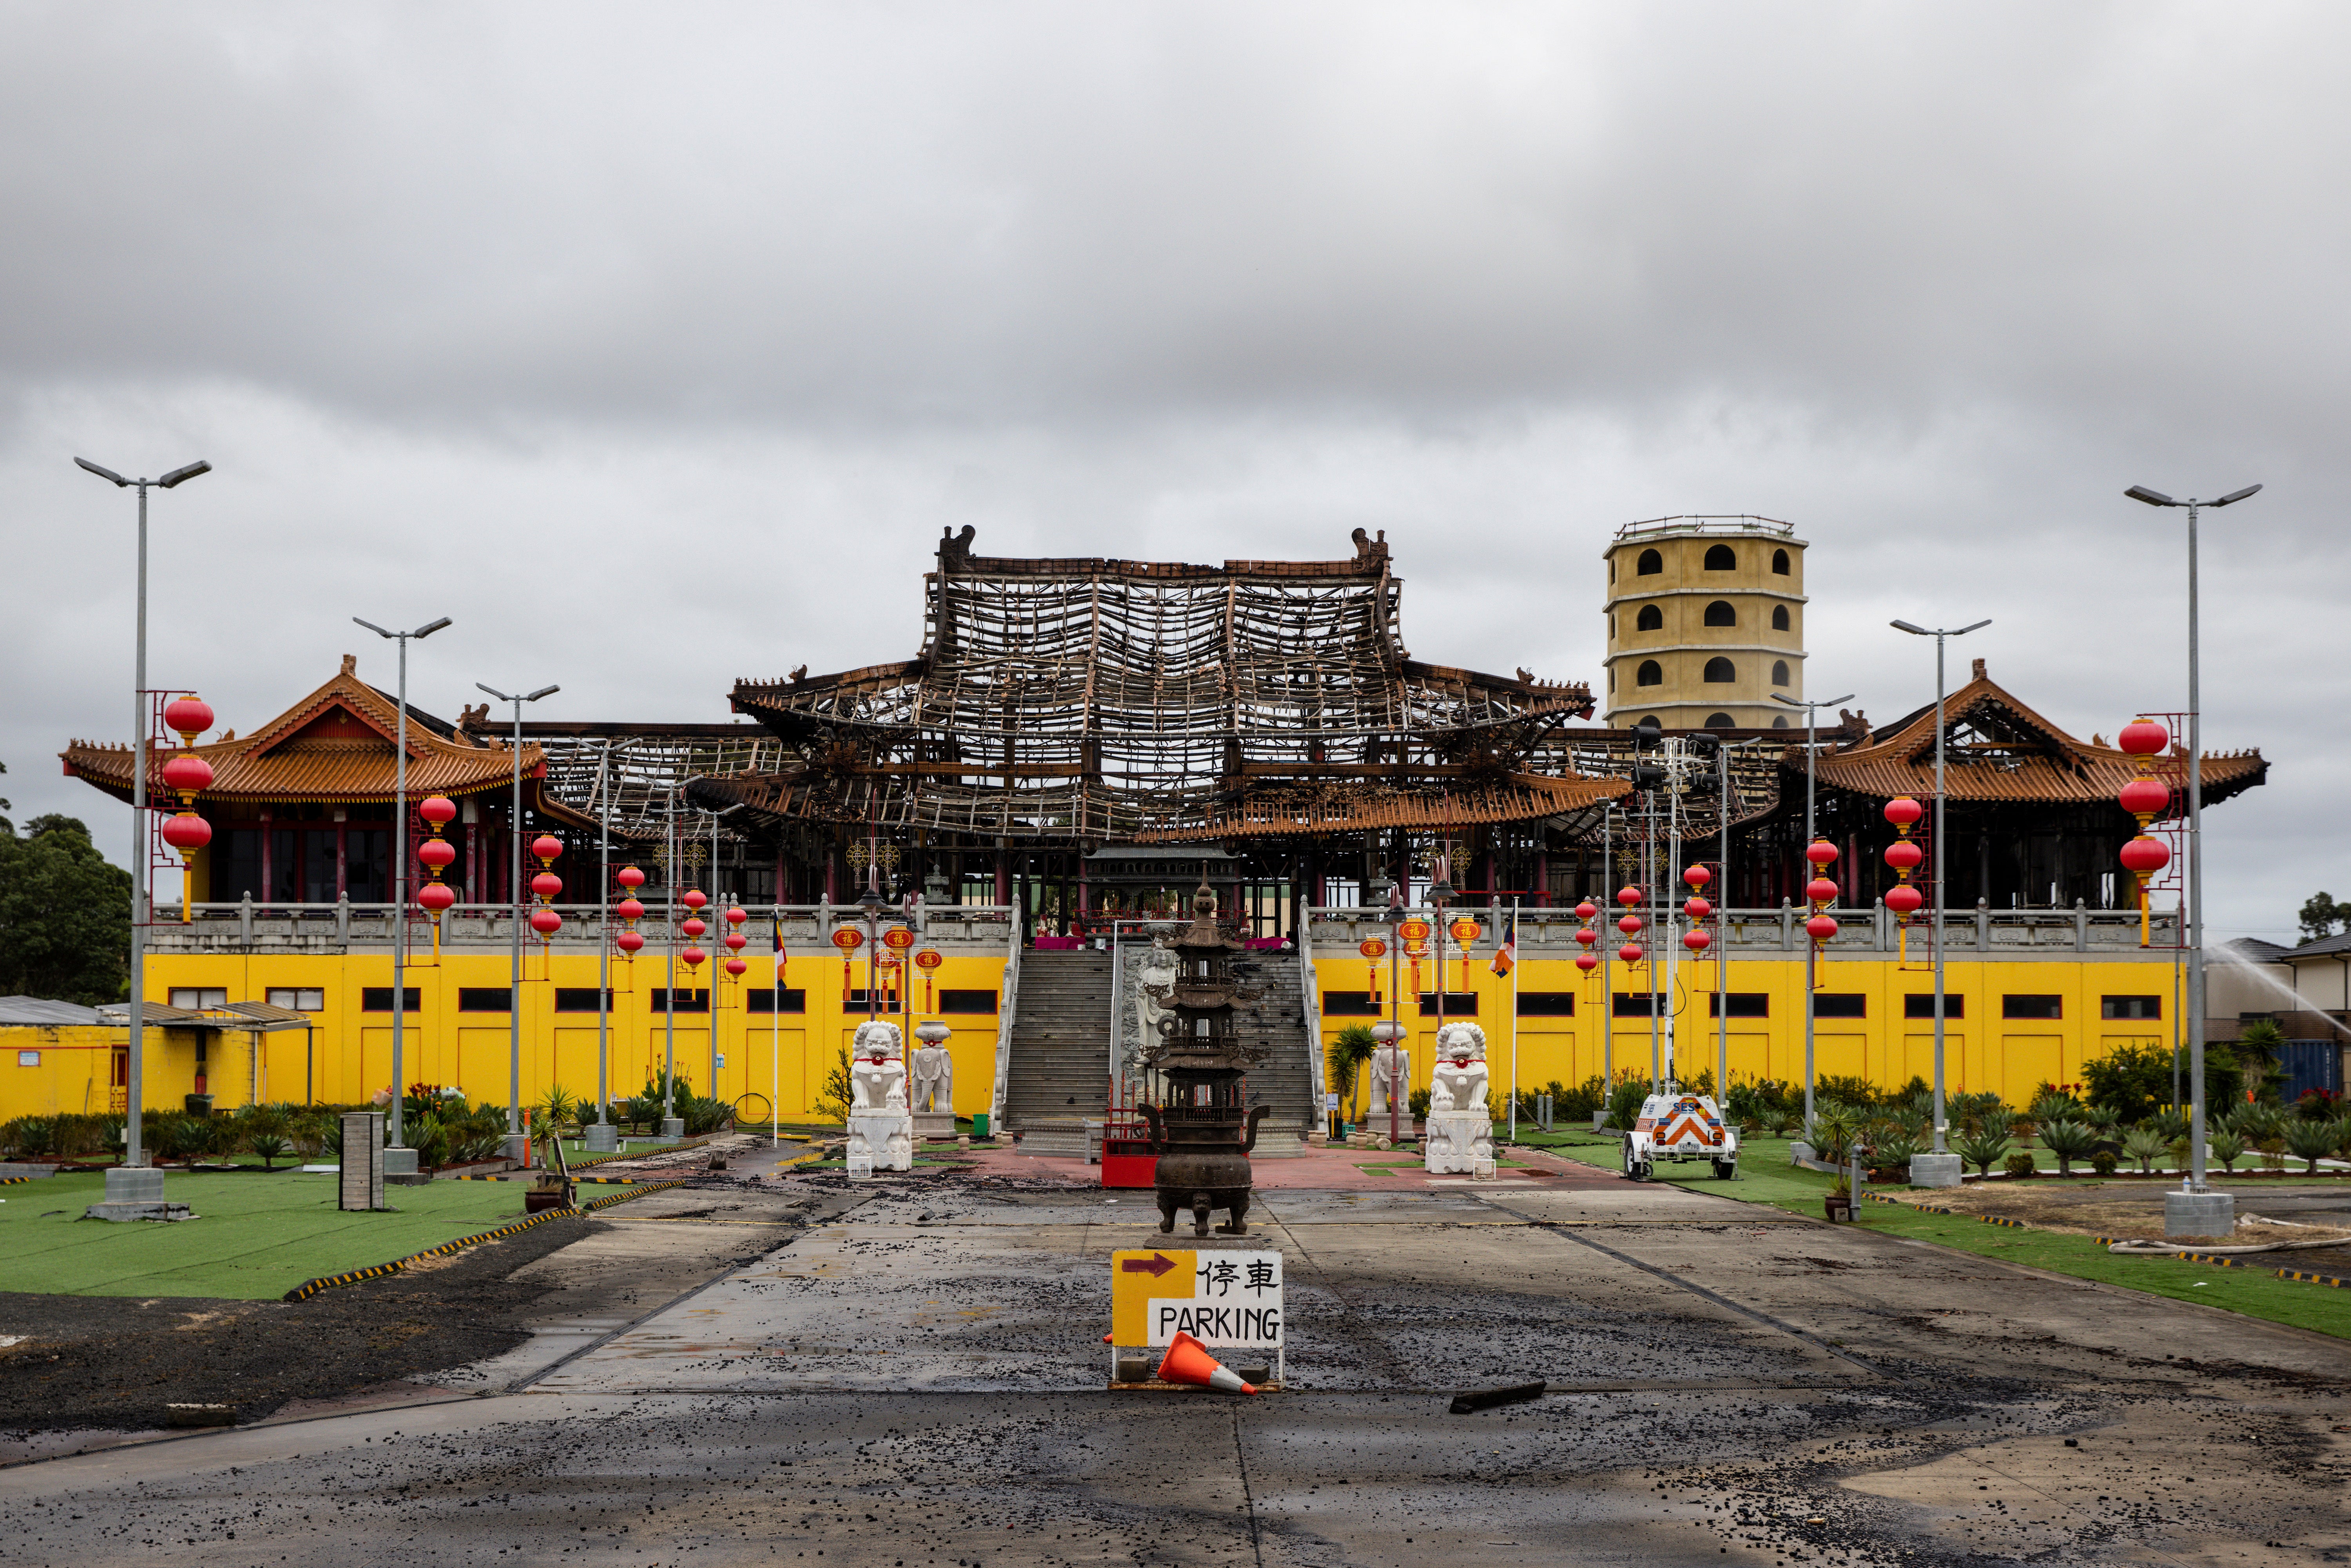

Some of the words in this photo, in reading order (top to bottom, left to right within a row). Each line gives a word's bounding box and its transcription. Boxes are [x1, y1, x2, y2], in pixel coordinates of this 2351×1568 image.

[1409, 925, 1420, 936] 福
[1460, 925, 1471, 936] 福
[842, 934, 853, 944] 福
[893, 934, 904, 944] 福
[1369, 944, 1378, 953] 福
[924, 955, 933, 964] 福
[1673, 1103, 1695, 1112] SES
[1197, 1258, 1280, 1298] 停車
[1161, 1307, 1280, 1341] PARKING
